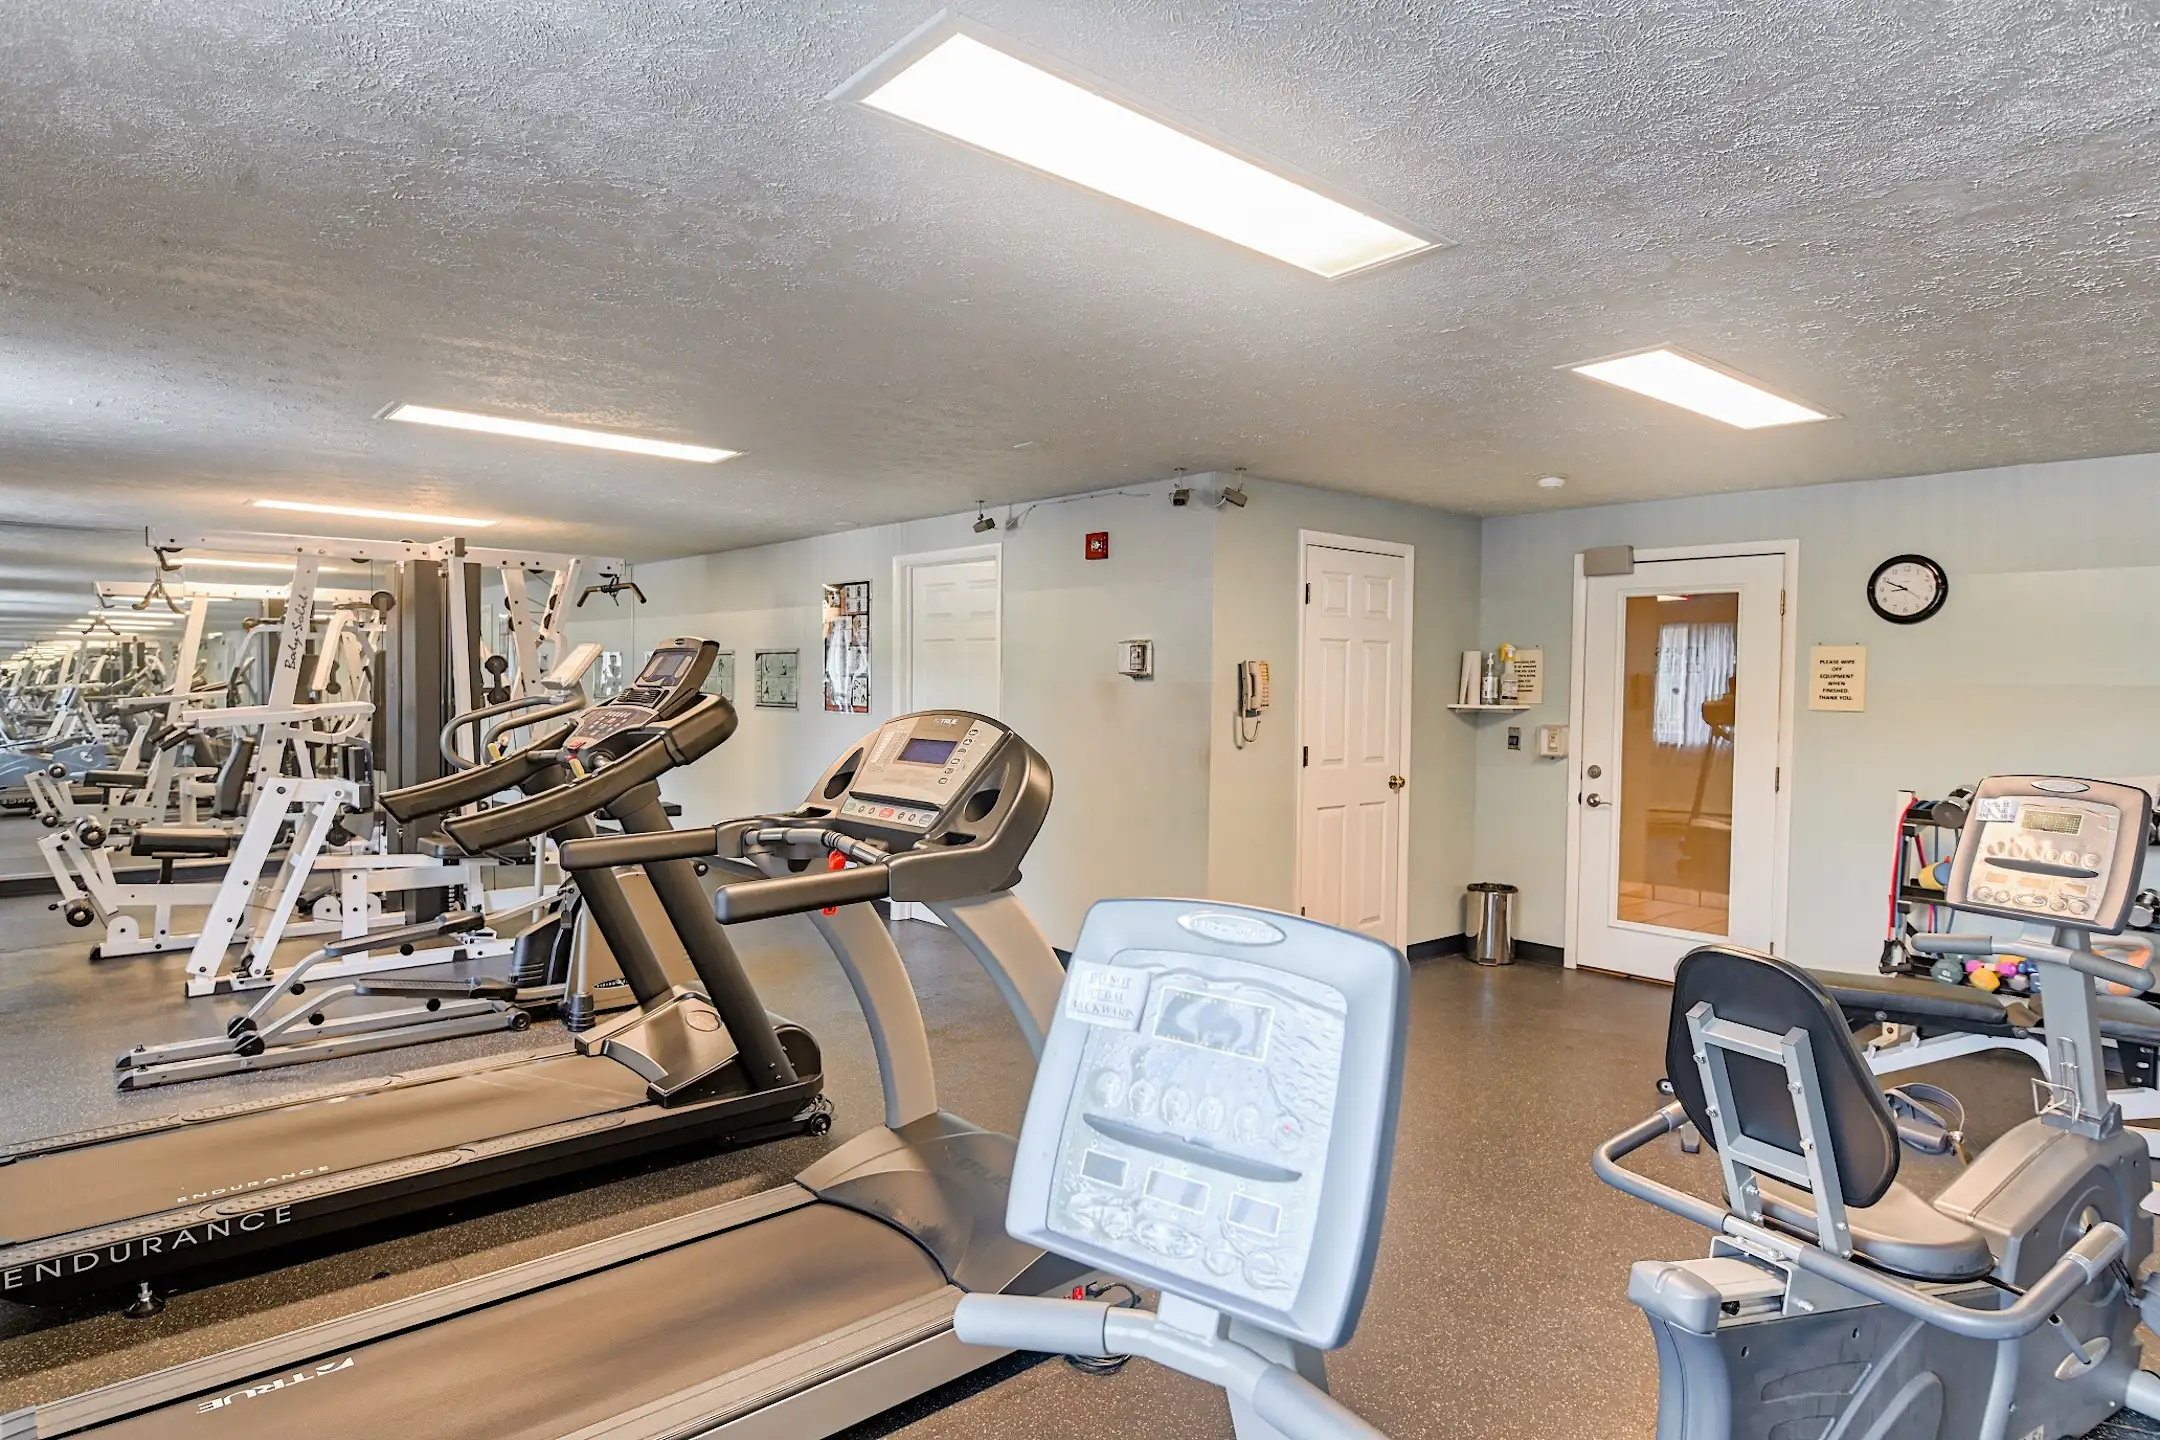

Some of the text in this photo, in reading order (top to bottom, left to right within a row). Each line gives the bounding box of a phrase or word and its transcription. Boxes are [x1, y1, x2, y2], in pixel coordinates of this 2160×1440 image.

[284, 594, 308, 670] Body-Solid
[3, 1205, 292, 1291] ENDURANCE
[196, 1370, 315, 1415] TRUE
